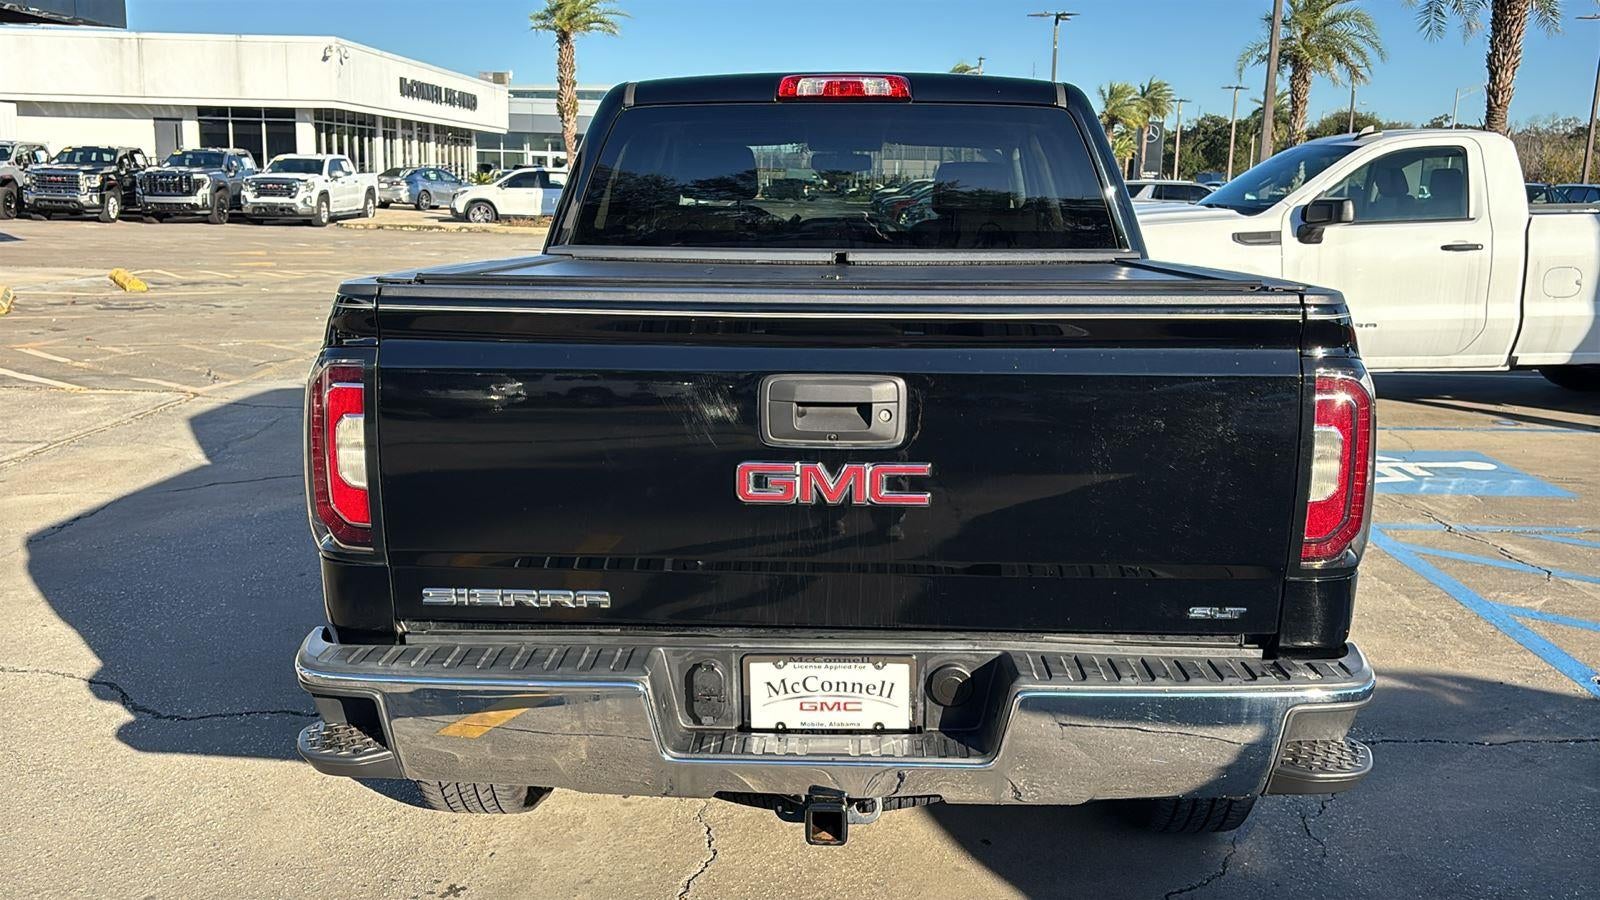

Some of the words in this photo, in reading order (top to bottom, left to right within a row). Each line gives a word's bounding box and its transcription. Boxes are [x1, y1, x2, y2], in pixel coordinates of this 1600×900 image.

[736, 461, 931, 506] GMC
[422, 587, 611, 608] SIERRA
[1188, 606, 1247, 619] SLT
[765, 675, 895, 699] McConnell
[799, 701, 863, 712] GMC
